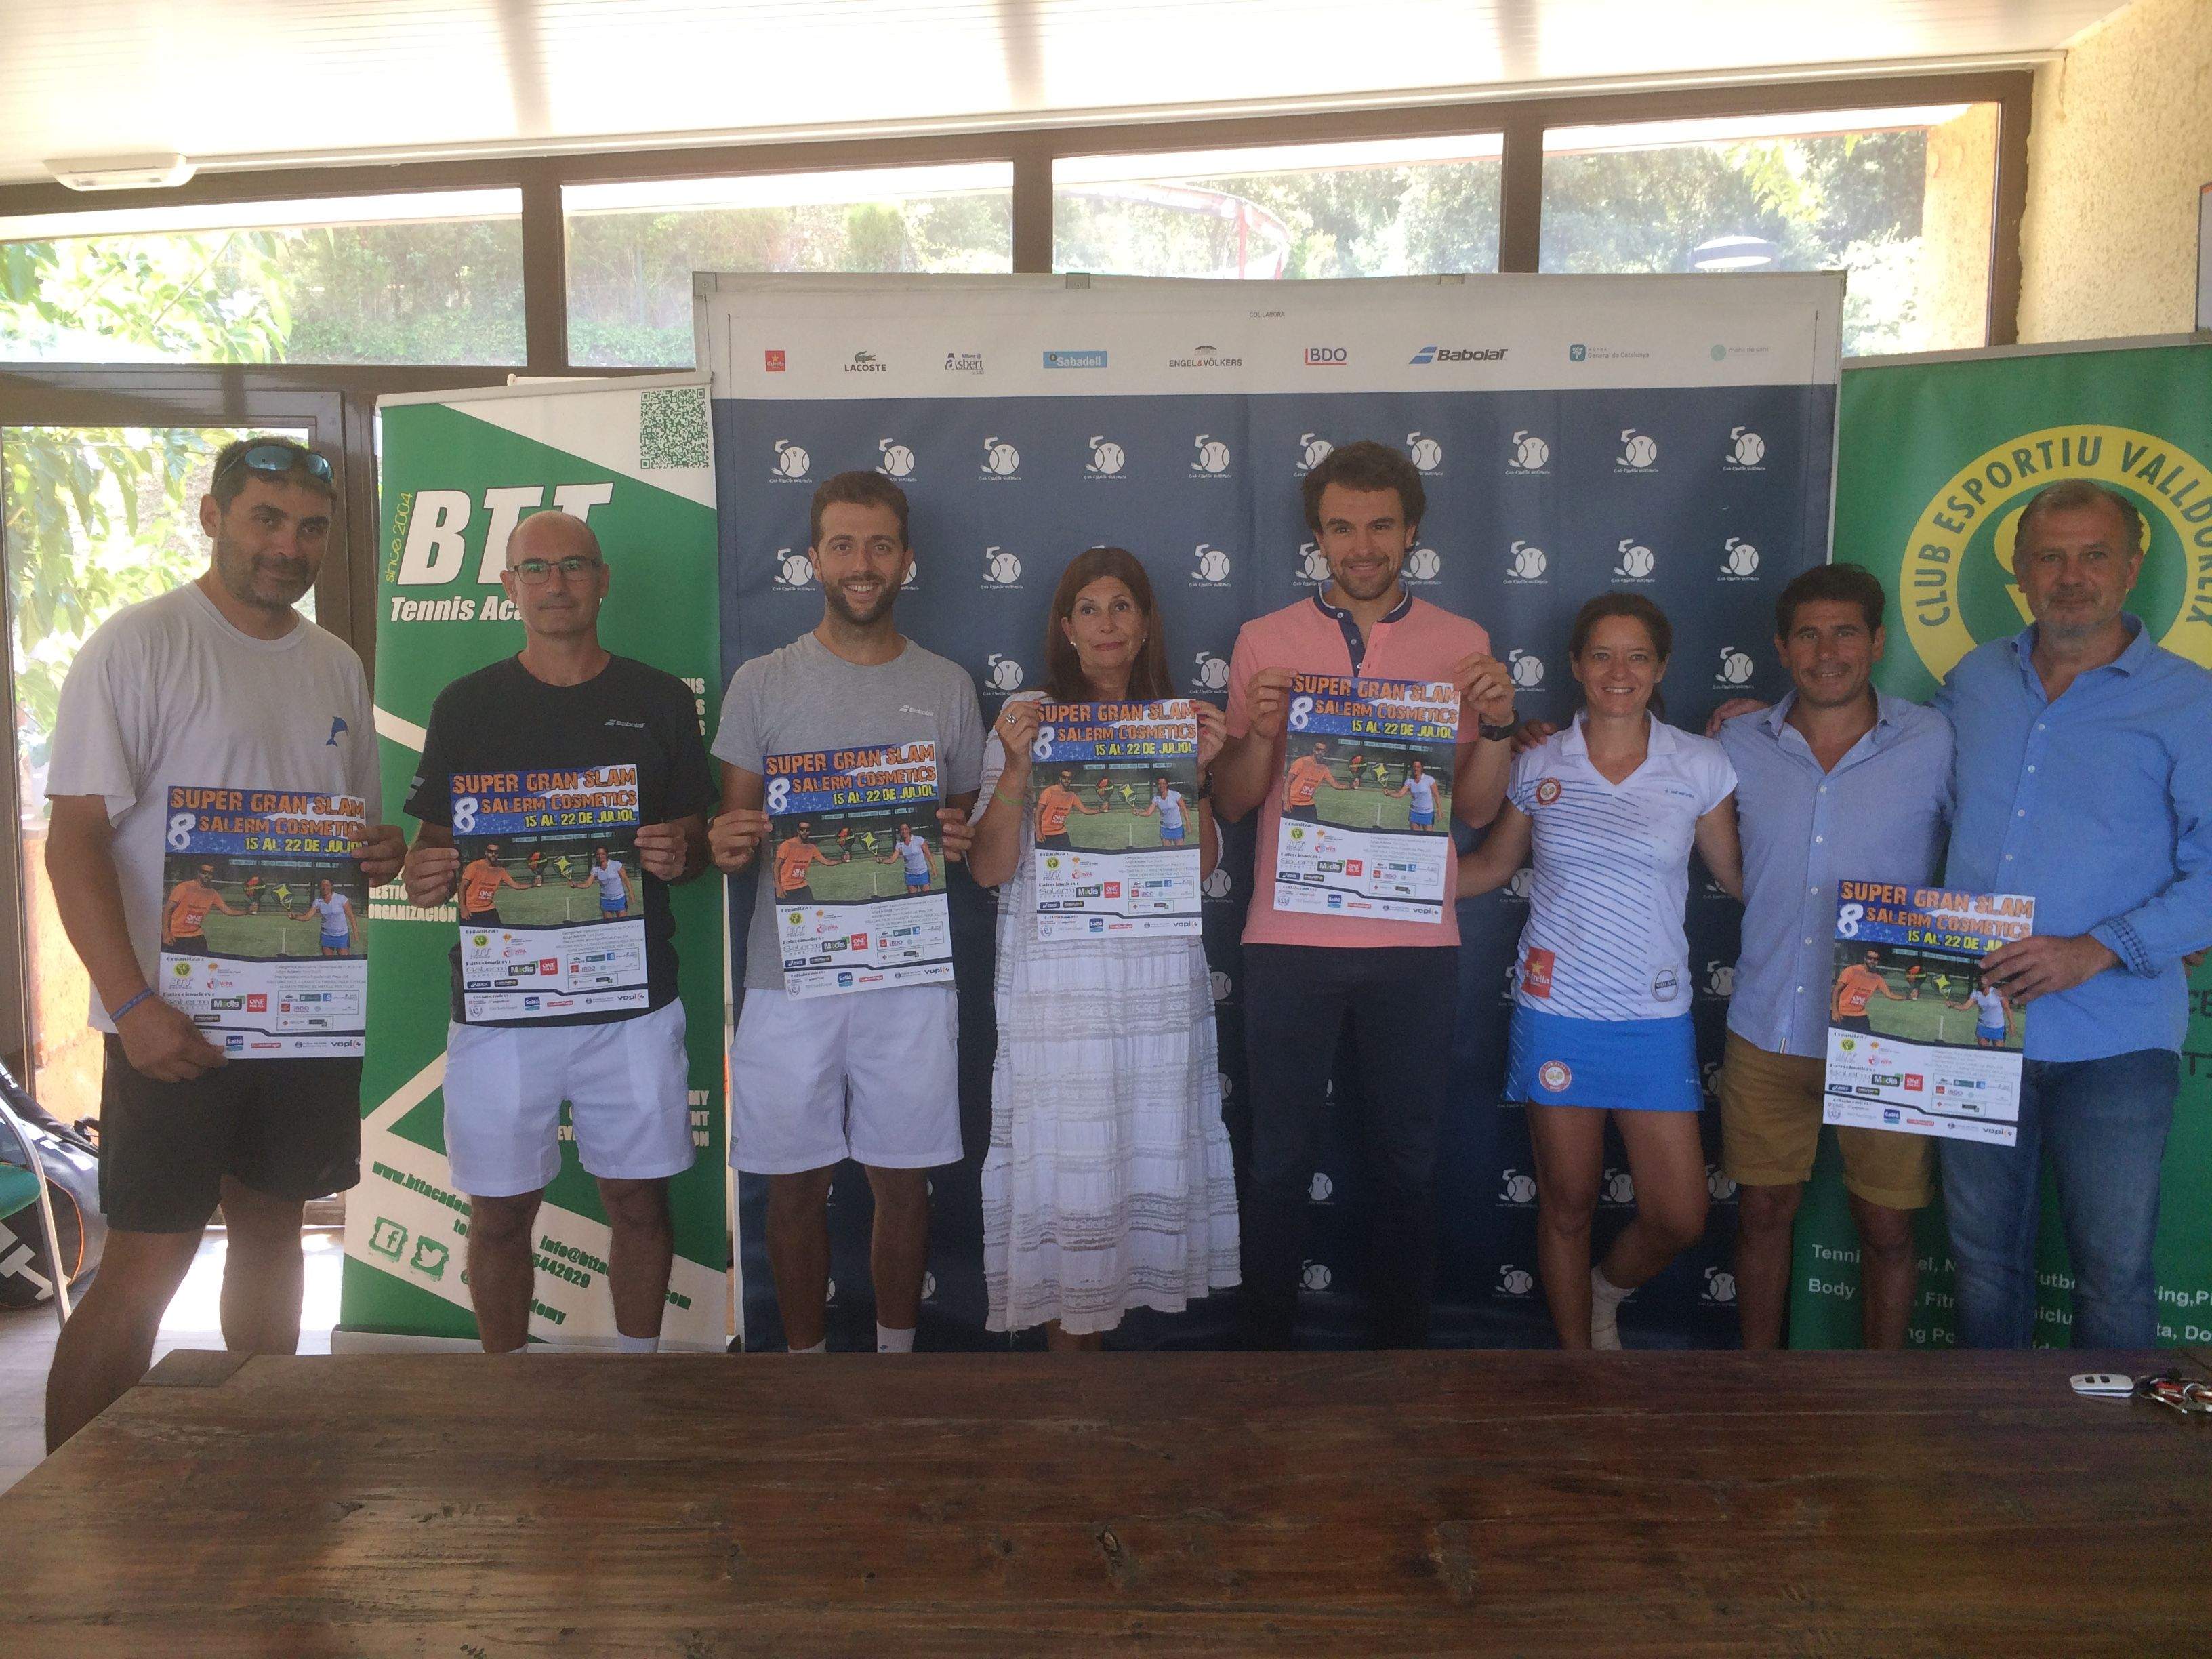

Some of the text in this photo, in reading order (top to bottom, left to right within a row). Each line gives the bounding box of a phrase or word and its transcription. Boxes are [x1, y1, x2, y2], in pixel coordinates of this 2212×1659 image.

[844, 364, 886, 372] LACOSTE
[1057, 356, 1101, 367] Sabadell
[1309, 348, 1347, 362] BDO
[1932, 435, 2102, 535] ESPORTIU
[386, 492, 413, 583] since 2004
[1914, 543, 1952, 627] CLUB
[390, 596, 476, 621] Tennis
[1293, 676, 1458, 705] SUPER GRAN SLAM
[1038, 701, 1196, 722] SUPER GRAN SLAM
[1290, 695, 1458, 729] 8 SALERM COSMETICS
[1033, 723, 1196, 760] 8 SALERM COSMETICS
[1351, 720, 1362, 732] 15
[1366, 721, 1380, 734] AL
[1384, 722, 1398, 735] 22
[1400, 724, 1414, 737] DE
[766, 744, 935, 775] SUPER GRAN SLAM
[1095, 743, 1105, 756] 15
[1109, 742, 1124, 756] AL
[1126, 743, 1140, 755] 22
[1143, 742, 1155, 754] DE
[452, 768, 636, 795] SUPER GRAN SLAM
[767, 766, 937, 815] 8 SALERM COSMETICS
[170, 787, 365, 819] SUPER GRAN SLAM
[833, 793, 845, 806] 15
[847, 792, 863, 804] AL
[866, 790, 881, 802] 22
[883, 788, 897, 801] DE
[453, 790, 637, 833] 8 SALERM COSMETICS
[525, 815, 537, 828] 15
[541, 813, 557, 827] AL
[561, 813, 575, 825] 22
[578, 811, 593, 825] DE
[168, 813, 197, 851] 8
[199, 815, 270, 834] SALERM
[245, 837, 257, 850] 15
[262, 838, 281, 852] AL
[285, 839, 302, 852] 22
[304, 840, 320, 853] DE
[368, 903, 457, 922] ORGANIZACIÓN
[1841, 882, 2033, 918] SUPER GRAN SLAM
[1837, 903, 2032, 939] 8 SALERM COSMETICS
[1908, 930, 1919, 943] 15
[1923, 932, 1941, 946] AL
[1944, 935, 1960, 947] 22
[1963, 936, 1979, 950] DE
[1812, 1244, 1861, 1264] Tenni
[1808, 1277, 1856, 1300] Body
